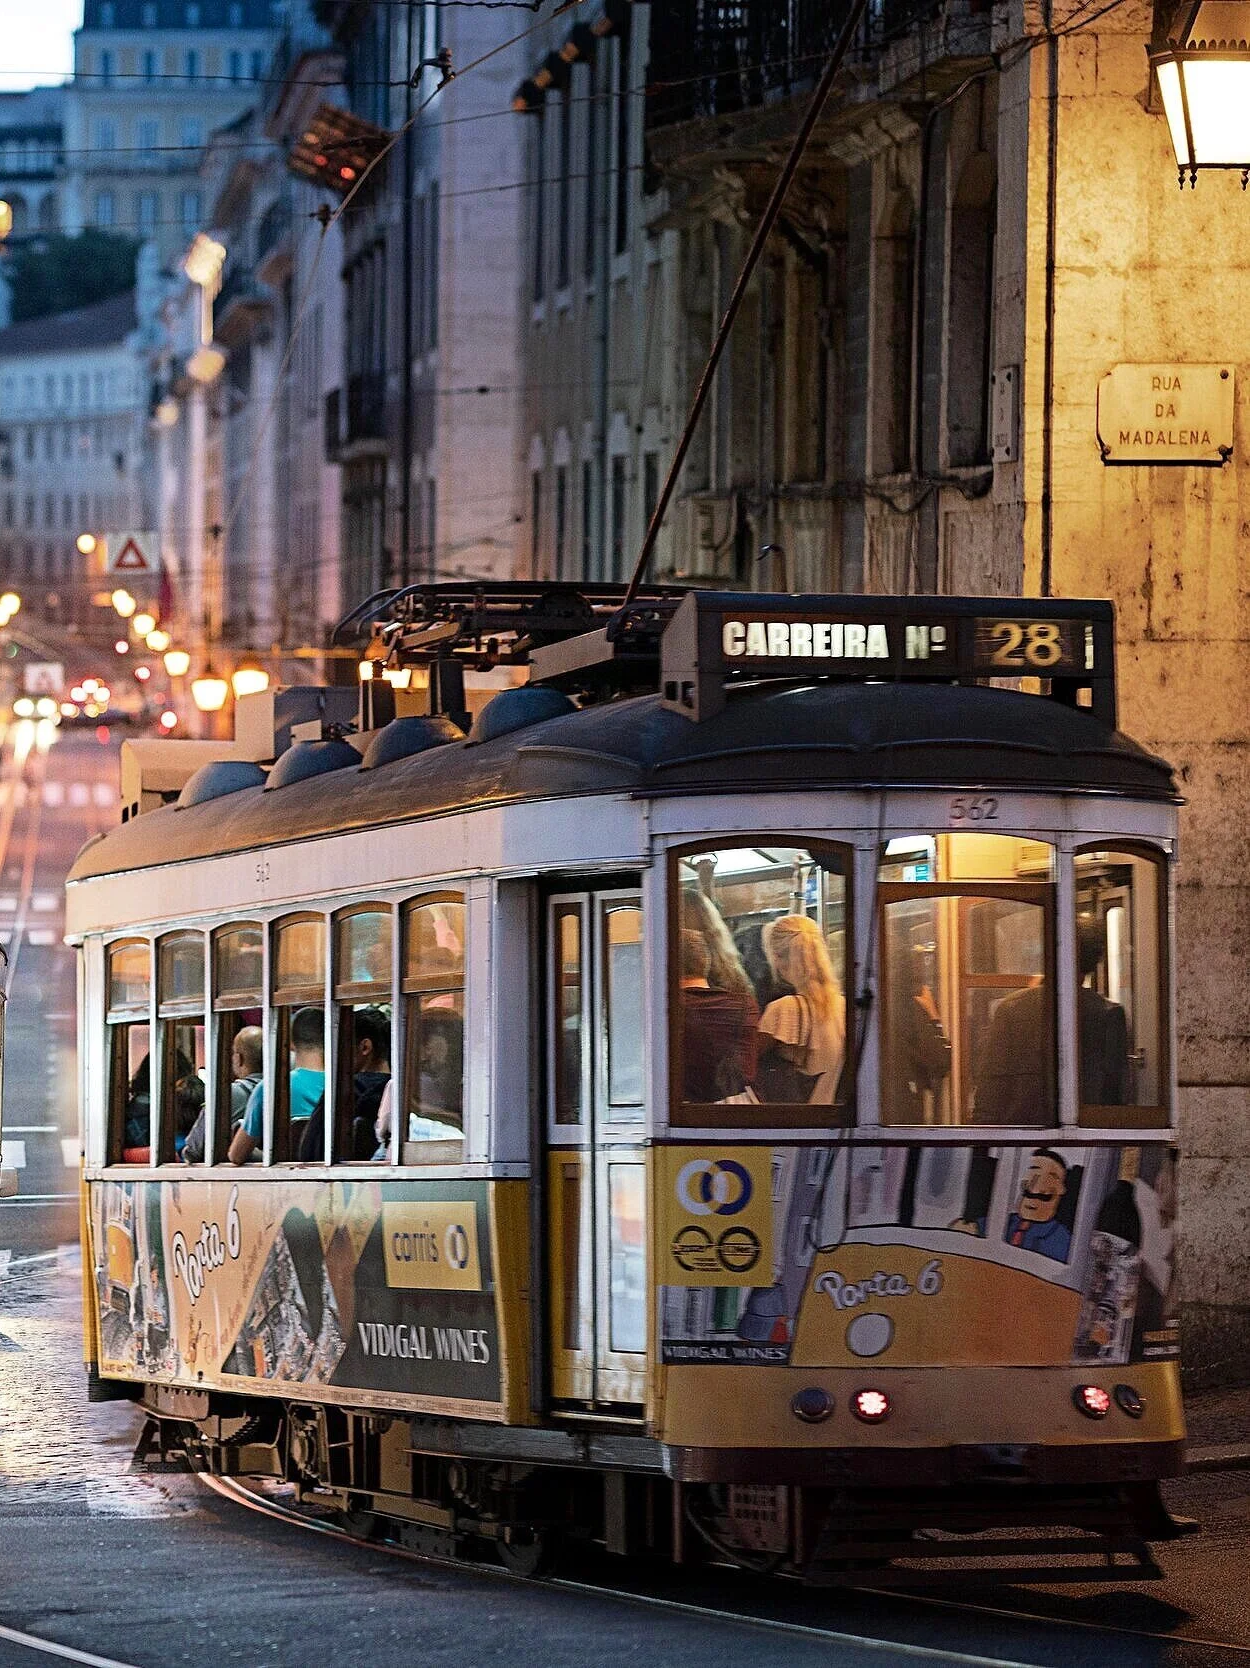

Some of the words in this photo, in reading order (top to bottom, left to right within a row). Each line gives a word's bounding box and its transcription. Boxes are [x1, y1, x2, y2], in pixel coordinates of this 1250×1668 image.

[1152, 376, 1182, 391] RUA
[1155, 403, 1176, 418] DA
[1119, 430, 1211, 445] MADALENA
[722, 621, 889, 658] CARREIRA
[990, 622, 1063, 666] 28
[950, 798, 997, 820] 562
[172, 1221, 226, 1307] Porta
[226, 1183, 242, 1260] 6
[813, 1270, 915, 1311] Porta
[916, 1259, 944, 1296] 6
[357, 1322, 432, 1360] VIDIGAL
[432, 1326, 490, 1365] WINES
[732, 1346, 789, 1360] WINES
